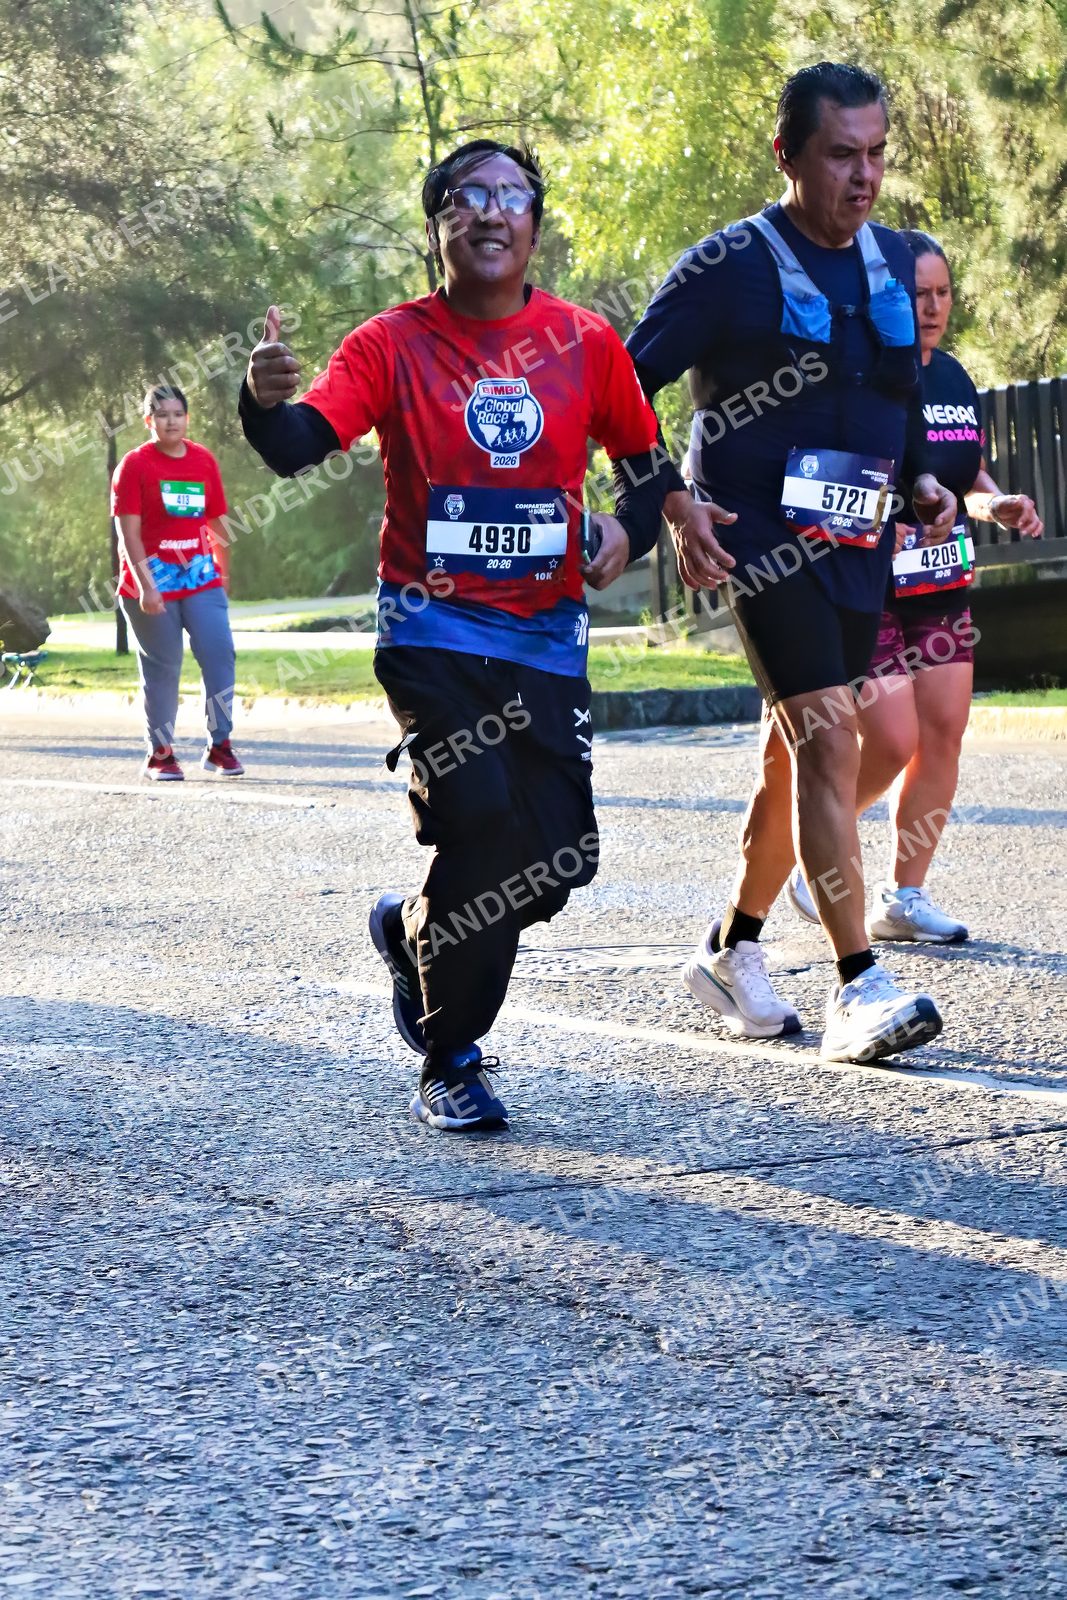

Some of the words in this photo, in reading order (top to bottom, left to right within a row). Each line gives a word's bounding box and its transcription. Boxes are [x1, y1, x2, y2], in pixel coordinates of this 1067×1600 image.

[482, 385, 522, 395] BIMBO
[484, 399, 523, 413] Global
[477, 411, 508, 424] Race
[493, 456, 517, 466] 2026
[177, 495, 190, 505] 413
[821, 484, 867, 515] 5721
[468, 524, 531, 554] 4930
[921, 543, 958, 568] 4209
[534, 572, 552, 580] 10K
